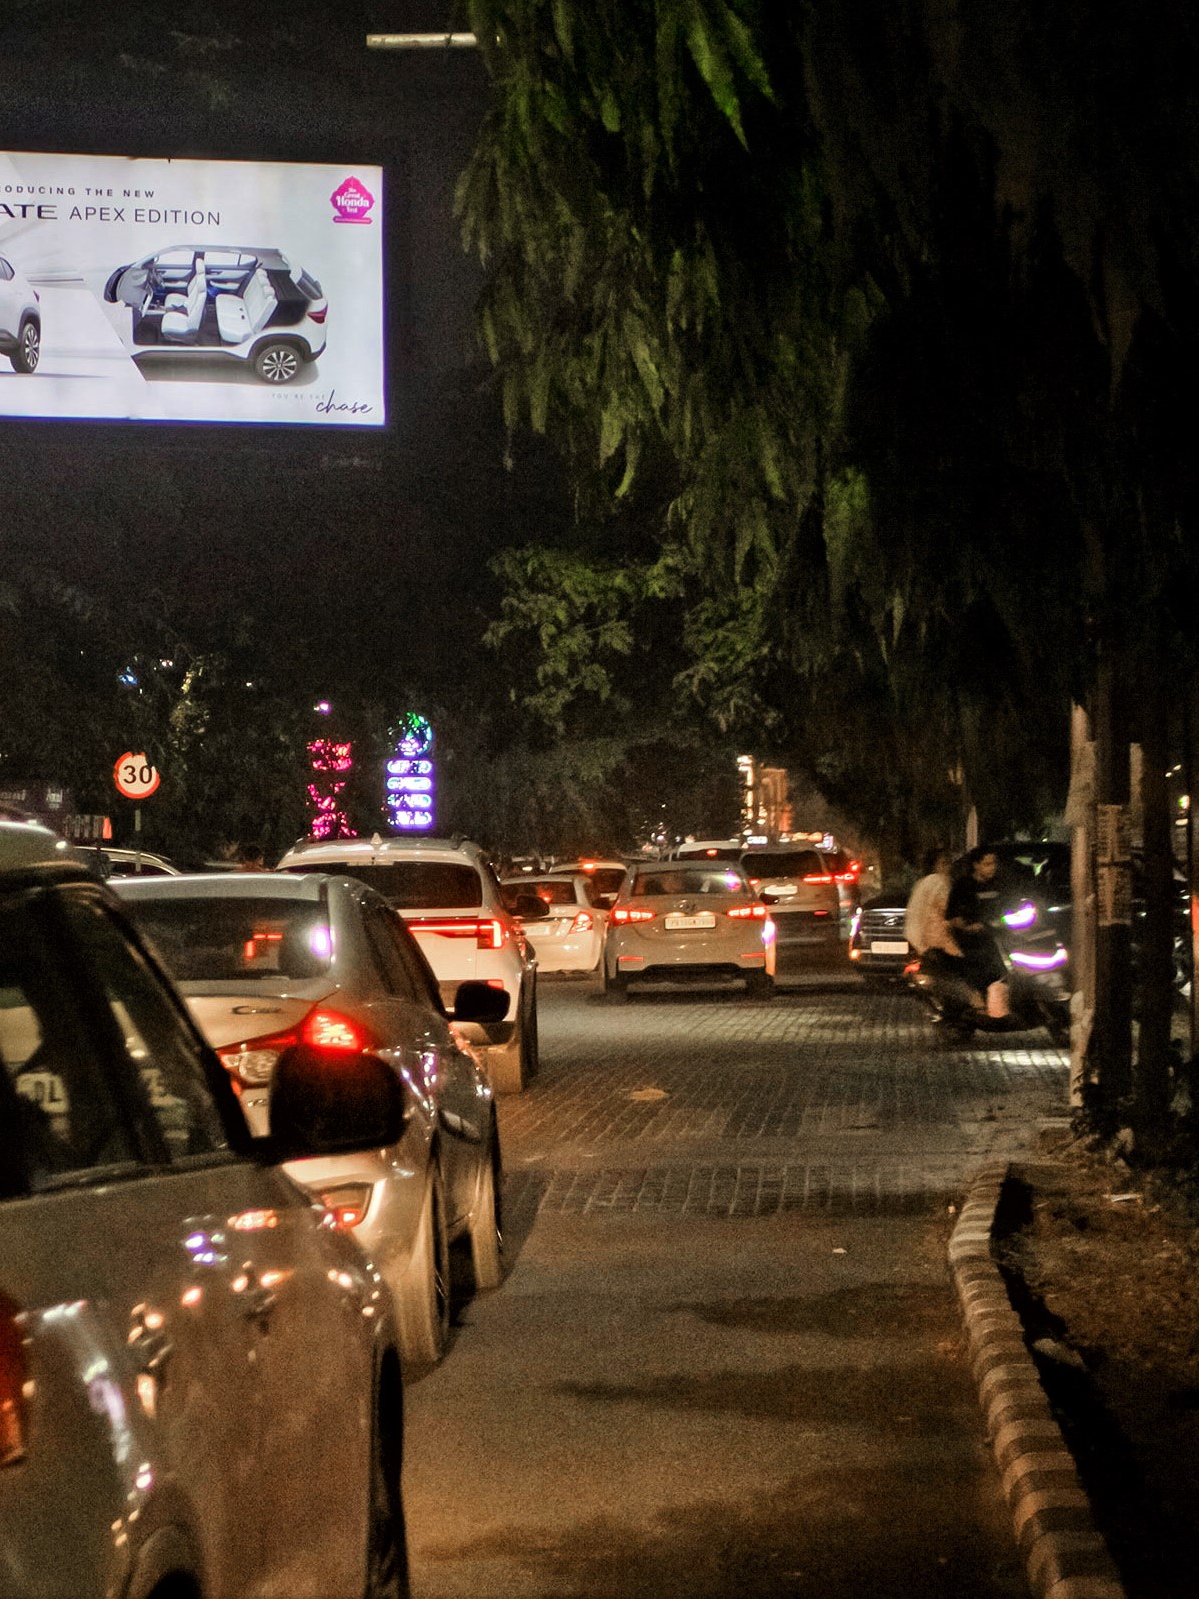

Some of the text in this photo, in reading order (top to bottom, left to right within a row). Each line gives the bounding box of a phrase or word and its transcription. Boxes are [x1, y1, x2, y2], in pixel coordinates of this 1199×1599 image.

[85, 187, 114, 197] THE
[123, 189, 155, 198] NEW
[336, 195, 370, 207] Honda
[69, 206, 125, 222] APEX
[134, 208, 220, 226] EDITION
[315, 387, 373, 414] chase
[123, 765, 153, 784] 30
